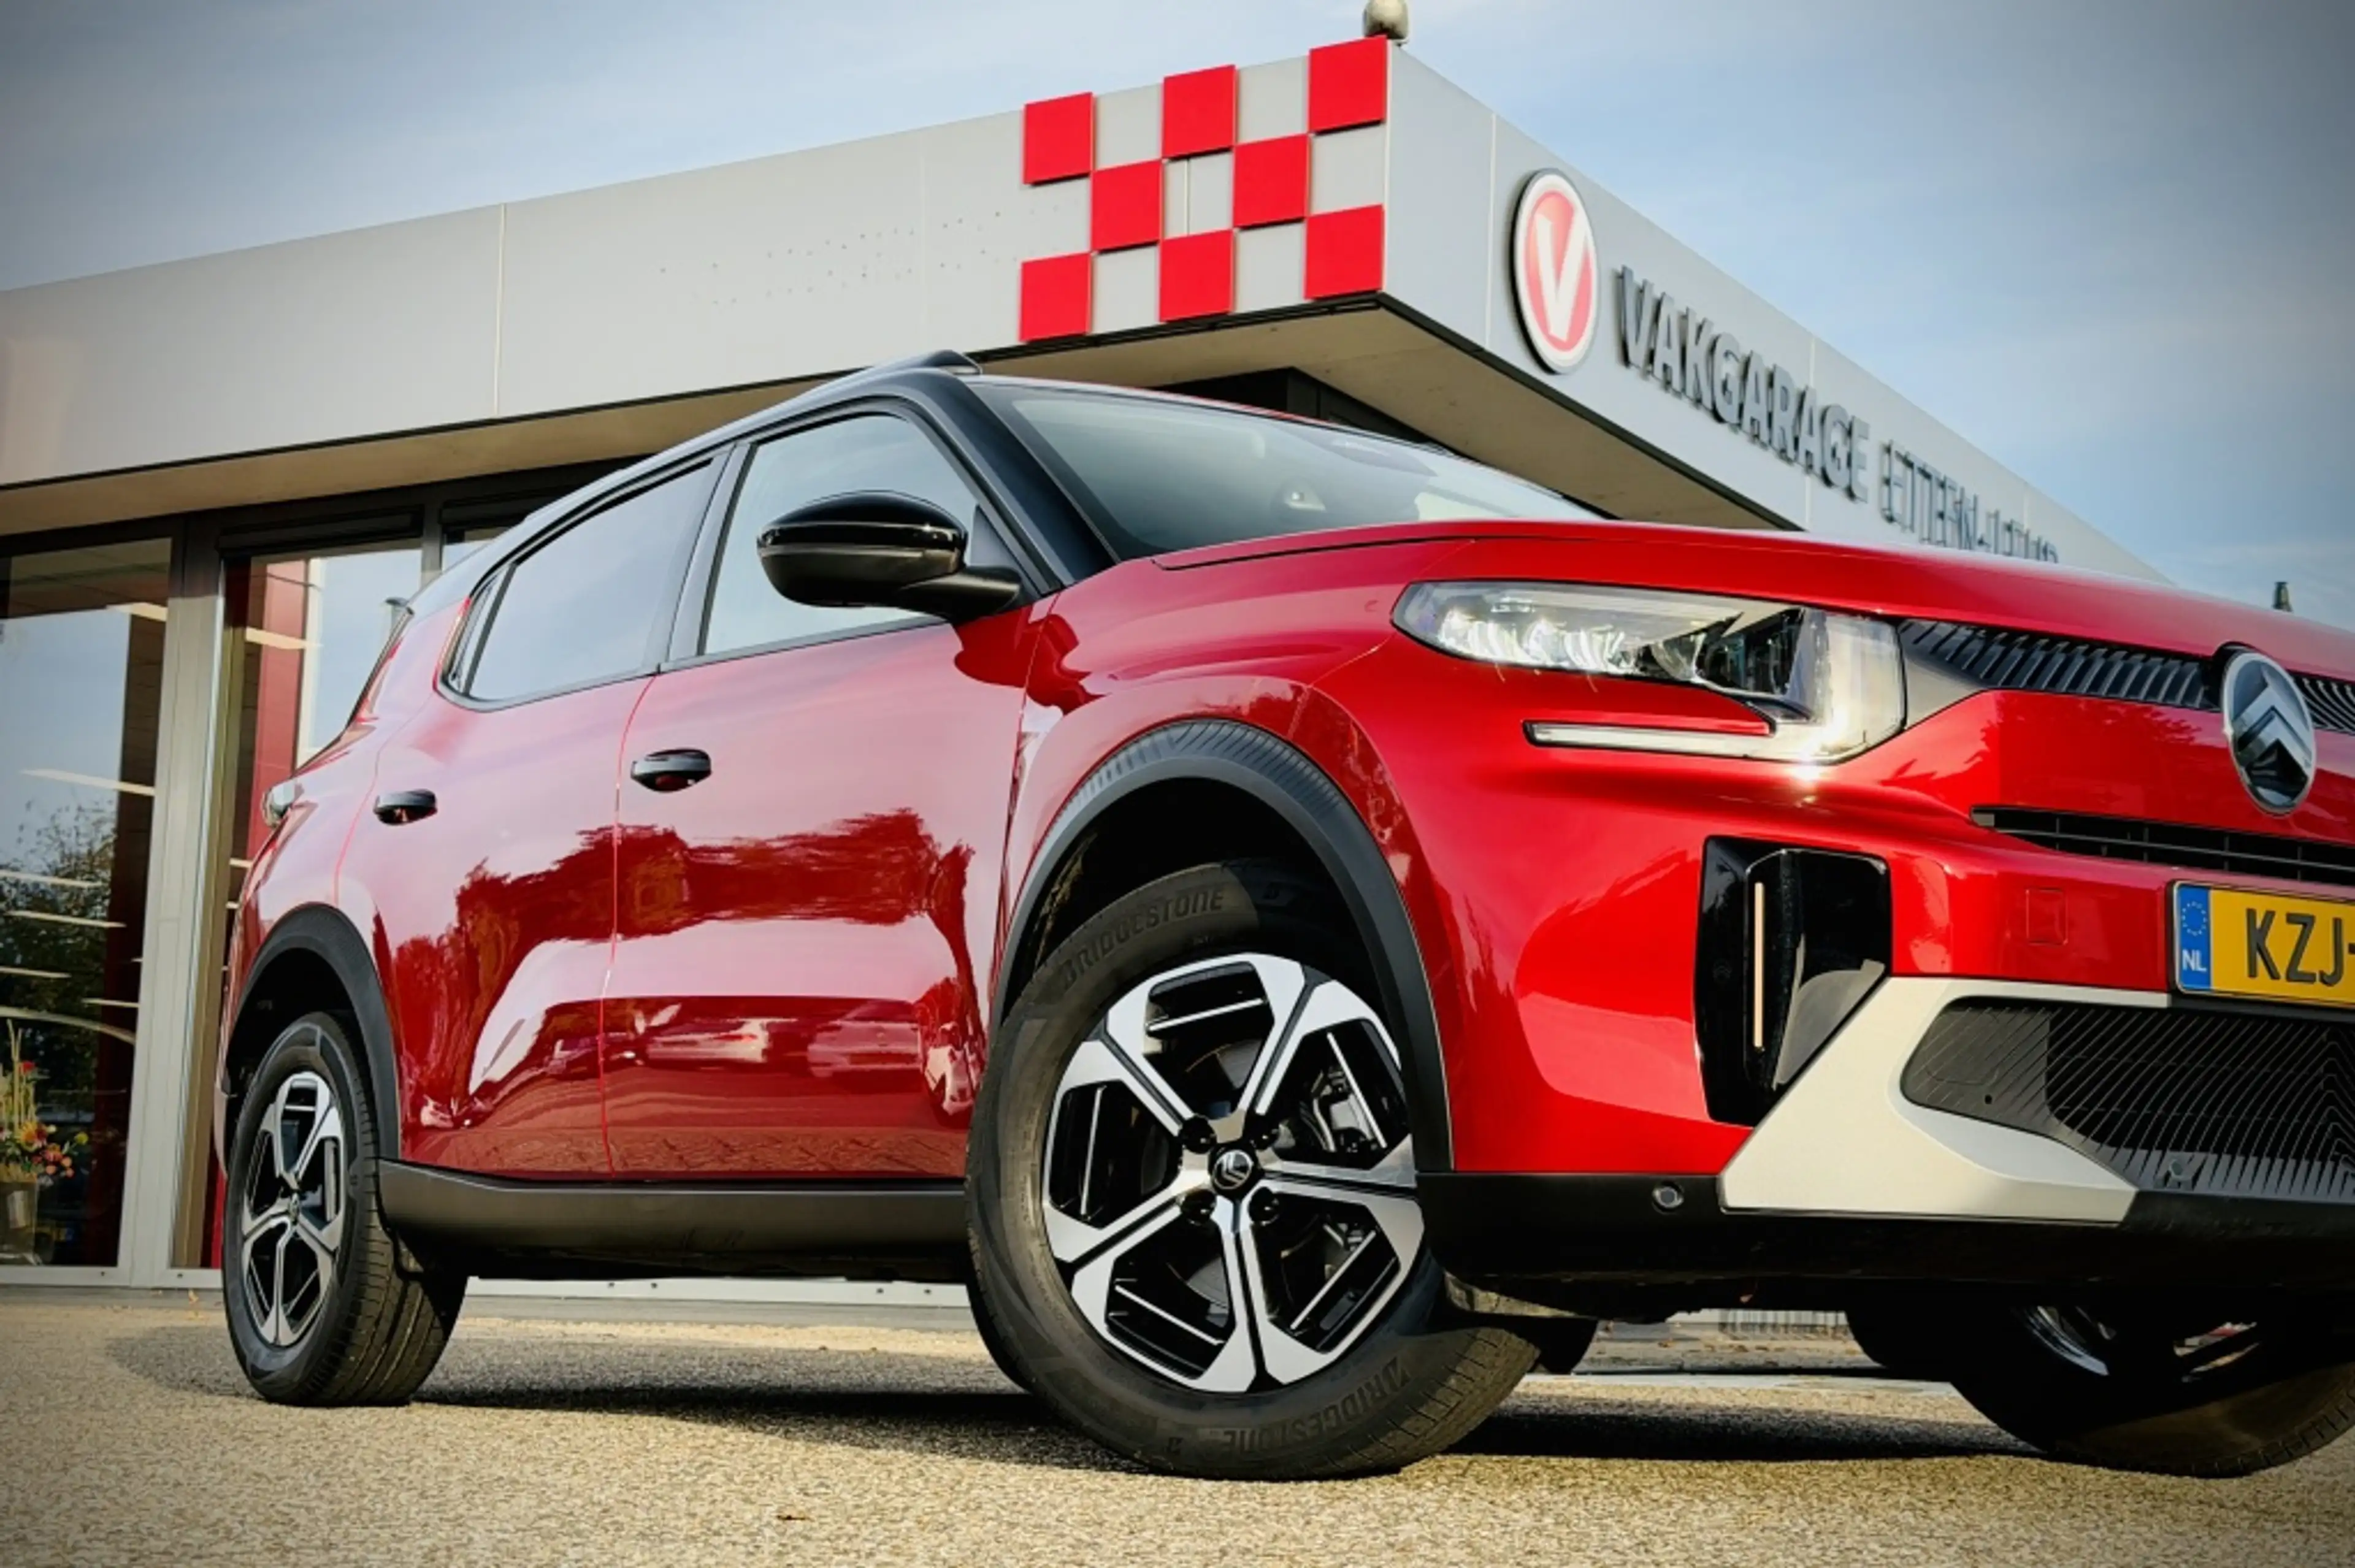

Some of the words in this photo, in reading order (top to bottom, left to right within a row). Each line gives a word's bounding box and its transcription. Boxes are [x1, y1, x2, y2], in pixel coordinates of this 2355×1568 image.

[1613, 265, 1870, 503] VAKGARAGE
[1058, 889, 1225, 989] BRIDGESTONE
[2181, 949, 2207, 972] NL
[1223, 1356, 1411, 1454] BRIDGESTONE
